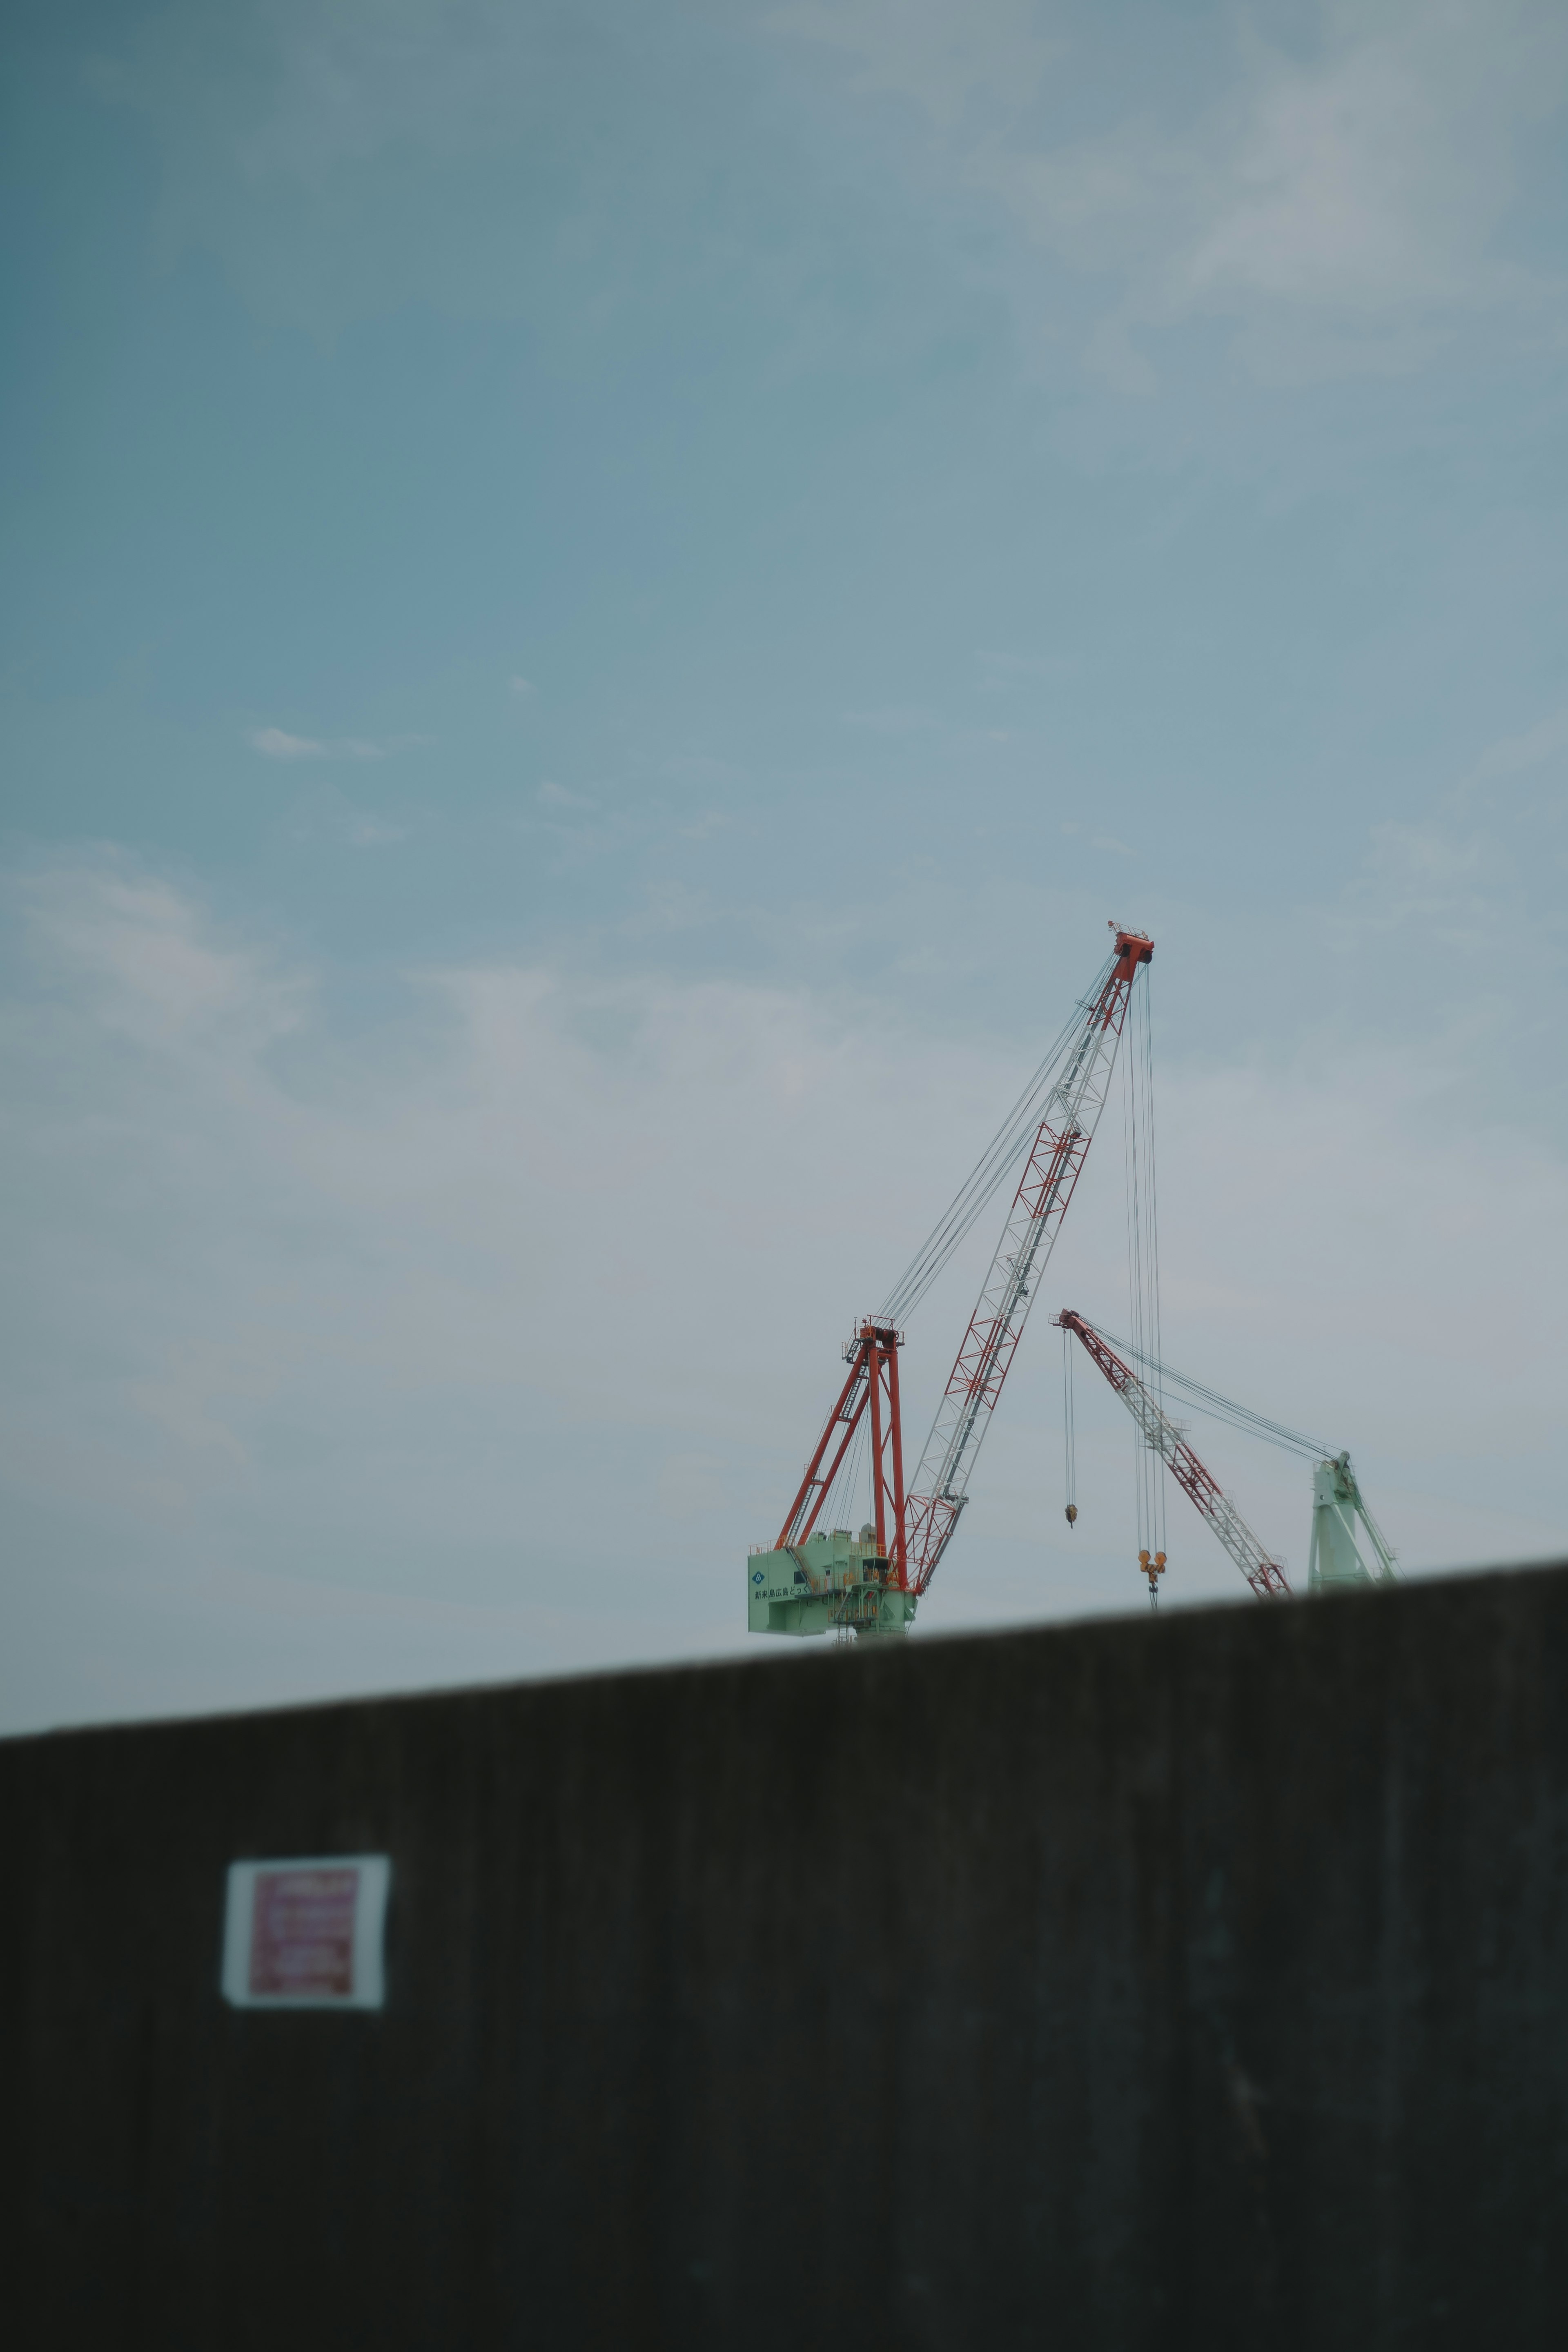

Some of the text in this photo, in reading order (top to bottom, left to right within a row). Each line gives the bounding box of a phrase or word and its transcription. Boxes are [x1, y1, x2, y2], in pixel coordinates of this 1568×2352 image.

[755, 1585, 808, 1599] 新来島広島どっく
